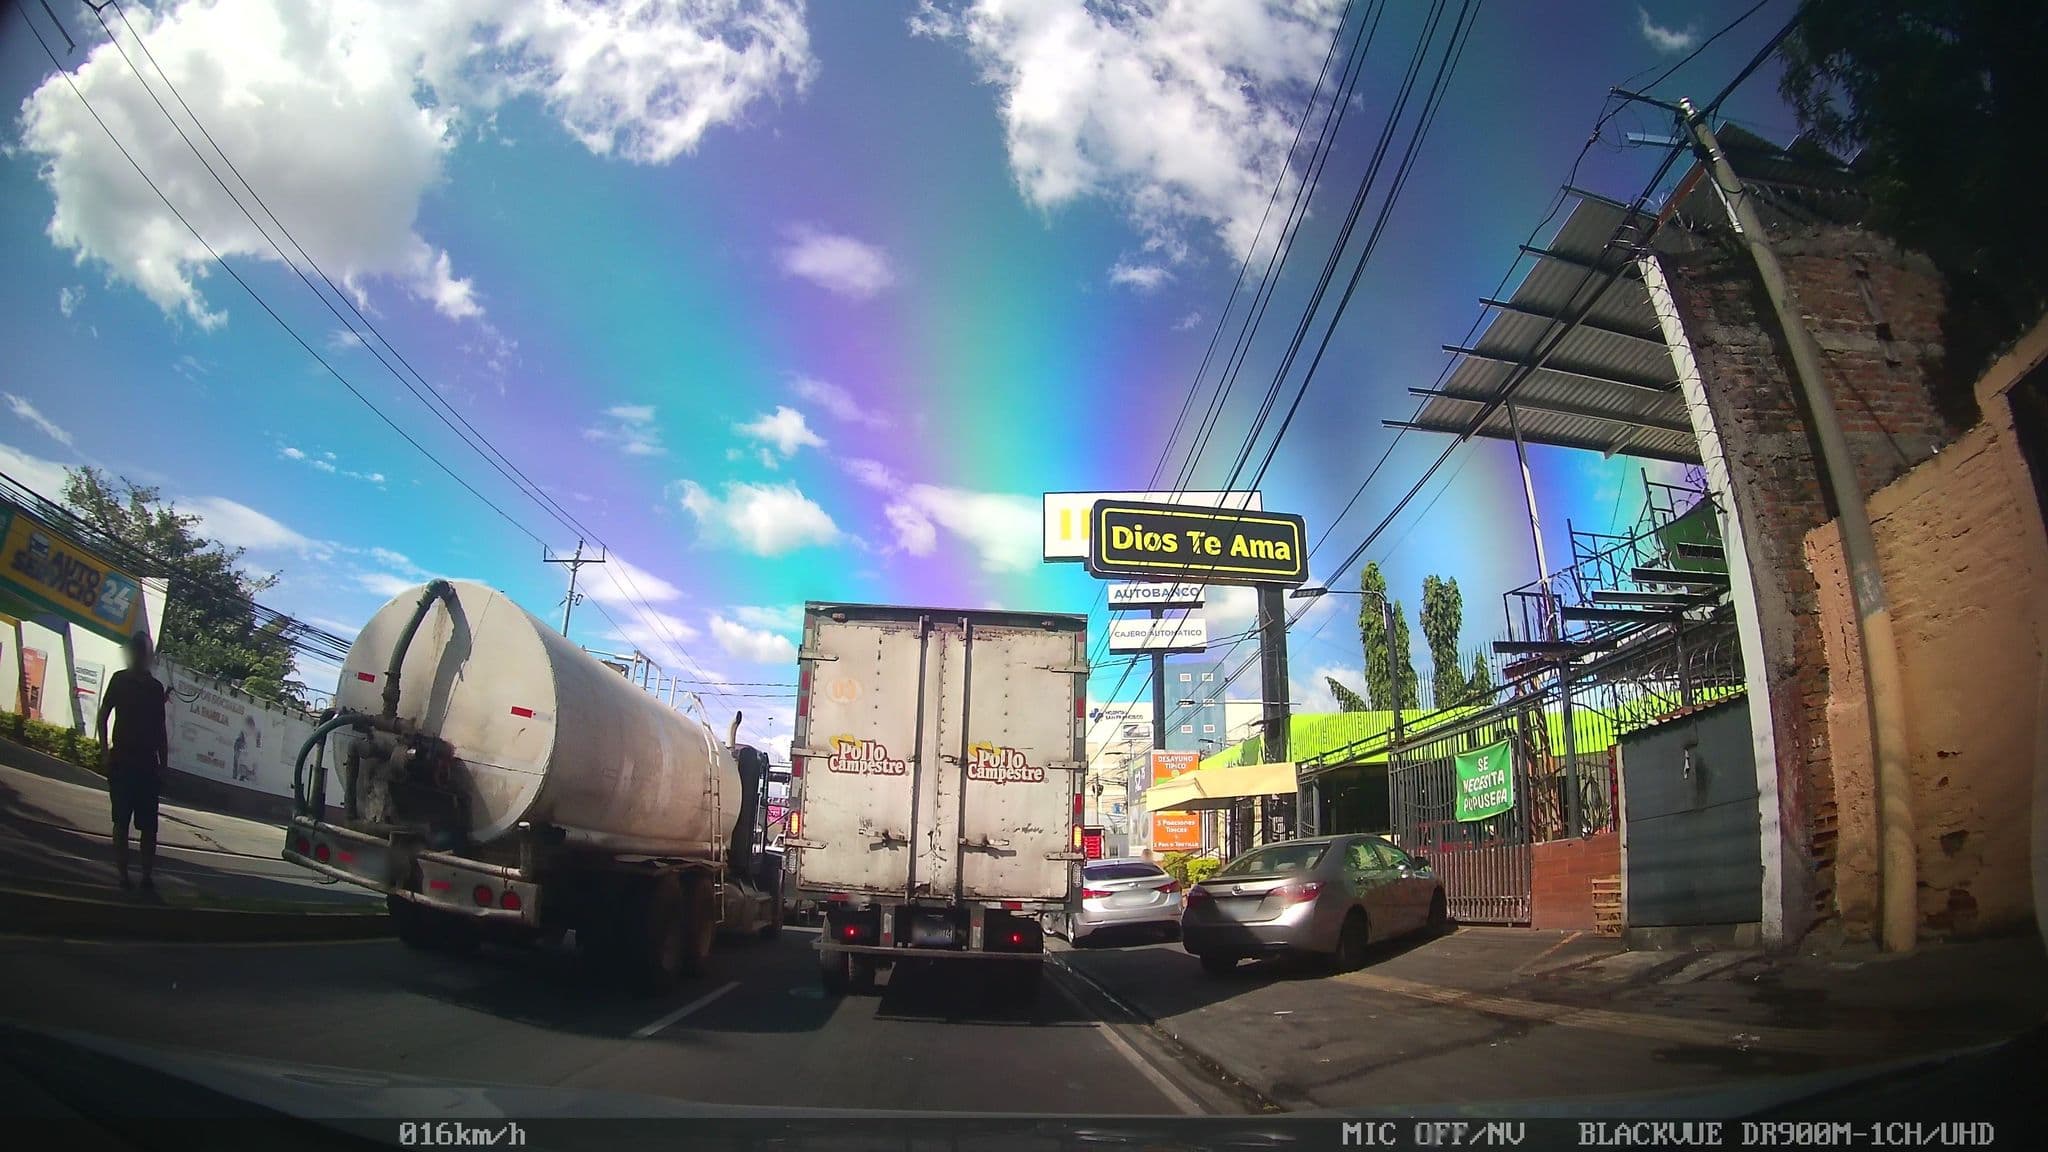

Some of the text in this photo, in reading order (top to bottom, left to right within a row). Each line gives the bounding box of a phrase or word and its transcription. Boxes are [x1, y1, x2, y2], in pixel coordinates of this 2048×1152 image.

[1111, 524, 1291, 561] Dios Te Ama
[100, 579, 131, 617] 24
[1114, 587, 1200, 599] AUTOBANCO
[1114, 630, 1147, 638] CAJERO
[839, 740, 885, 761] Pollo
[978, 748, 1024, 769] Pollo
[829, 755, 905, 776] Campestre
[967, 763, 1043, 783] Campestre
[1478, 756, 1488, 772] SE
[1463, 770, 1504, 793] NECESITA
[1464, 789, 1507, 812] PUPUSERA
